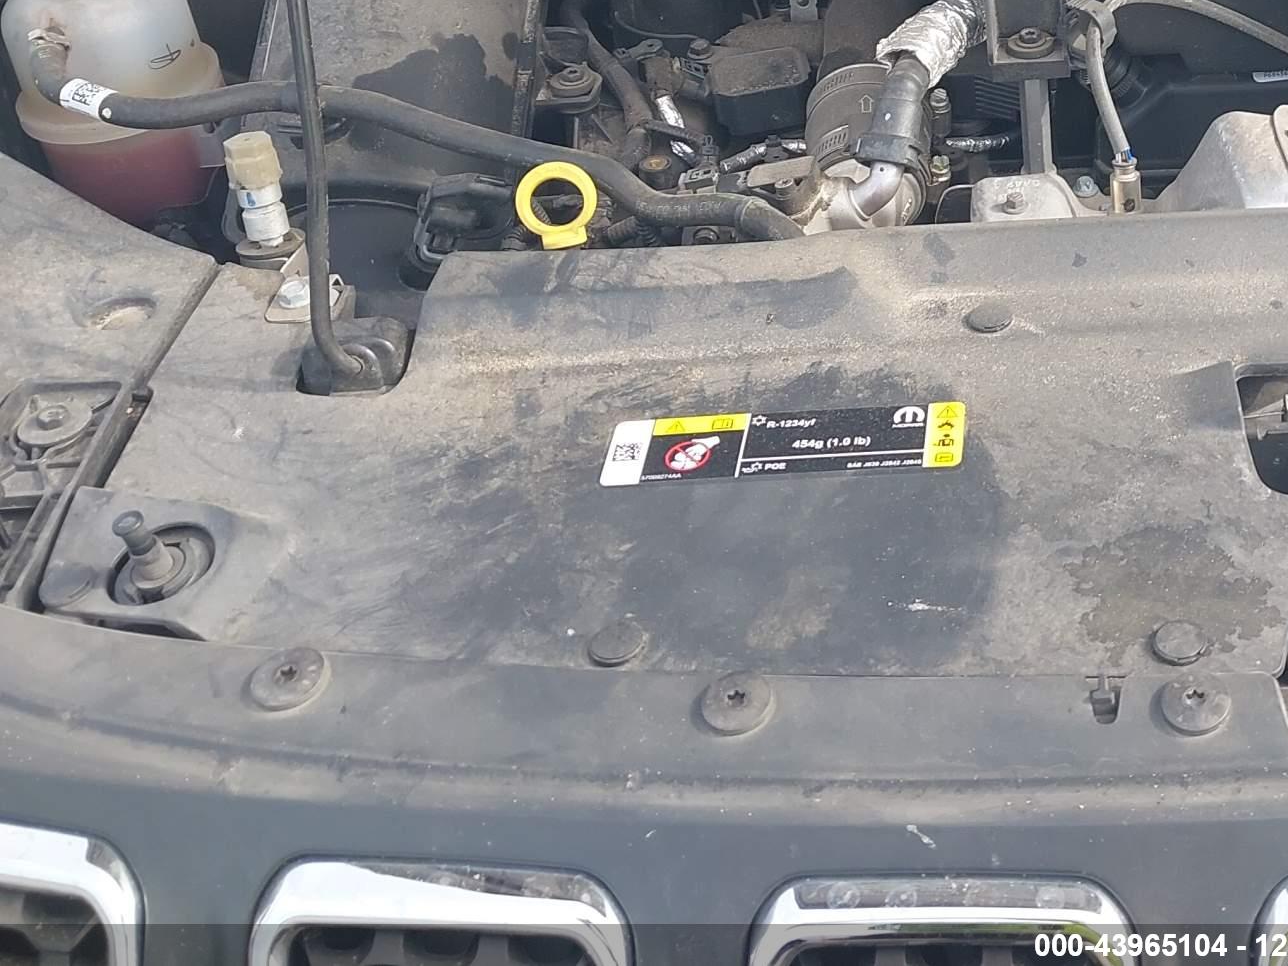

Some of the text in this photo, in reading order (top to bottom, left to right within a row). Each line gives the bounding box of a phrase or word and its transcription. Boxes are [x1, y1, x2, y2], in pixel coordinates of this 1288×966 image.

[766, 418, 817, 429] R-1234yf
[792, 436, 872, 450] 454g (1.0 lb)
[764, 462, 787, 471] POE
